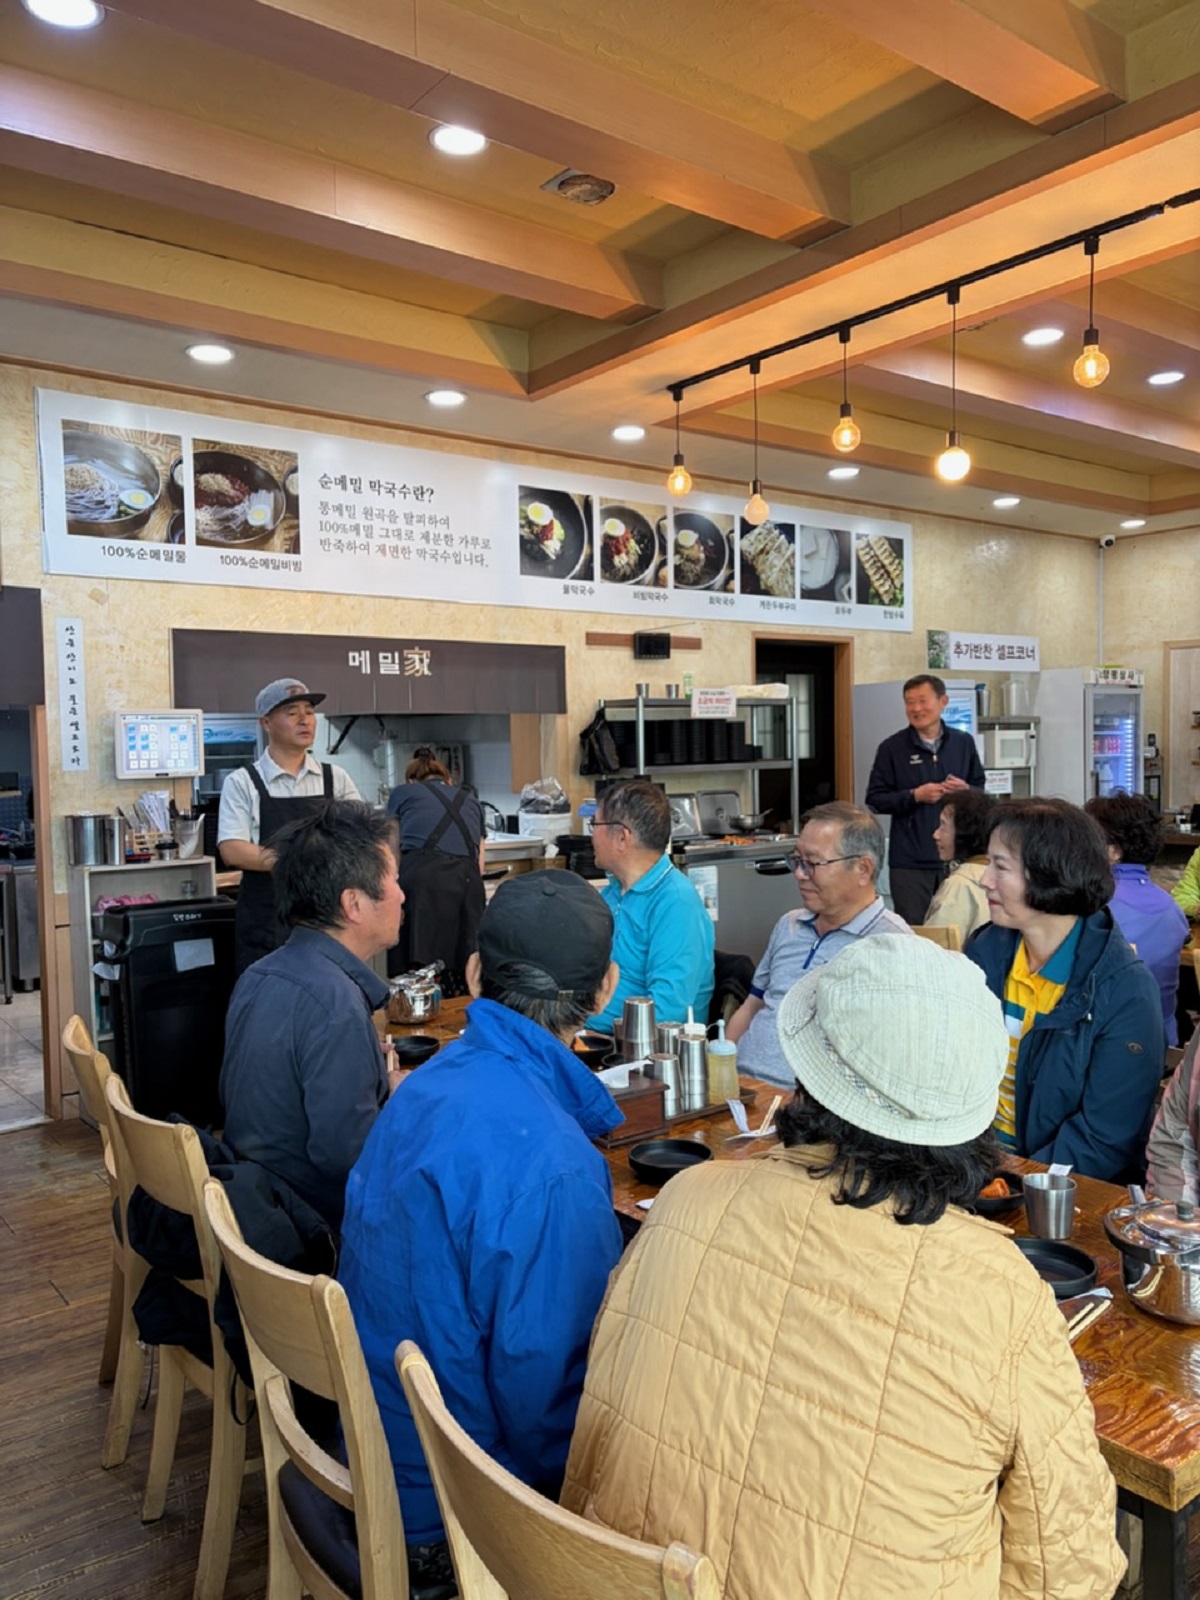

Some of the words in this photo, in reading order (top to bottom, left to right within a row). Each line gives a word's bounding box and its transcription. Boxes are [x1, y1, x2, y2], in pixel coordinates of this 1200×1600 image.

[318, 473, 363, 494] 순메밀
[368, 480, 435, 503] 막국수란?
[318, 501, 357, 520] 통메밀
[362, 506, 399, 524] 원곡을
[403, 511, 450, 530] 탈피하여
[319, 520, 374, 539] 100%메밀
[379, 527, 416, 542] 그대로
[458, 535, 492, 550] 가루로
[101, 545, 186, 564] 100%순메밀물
[319, 538, 371, 556] 반죽하여
[416, 548, 489, 568] 막국수입니다.
[220, 555, 302, 573] 100%순메밀비빔
[563, 584, 595, 596] 물막국수
[633, 591, 669, 602] 비빔막국수
[953, 641, 993, 660] 추가반찬
[996, 644, 1036, 661] 셀프코너
